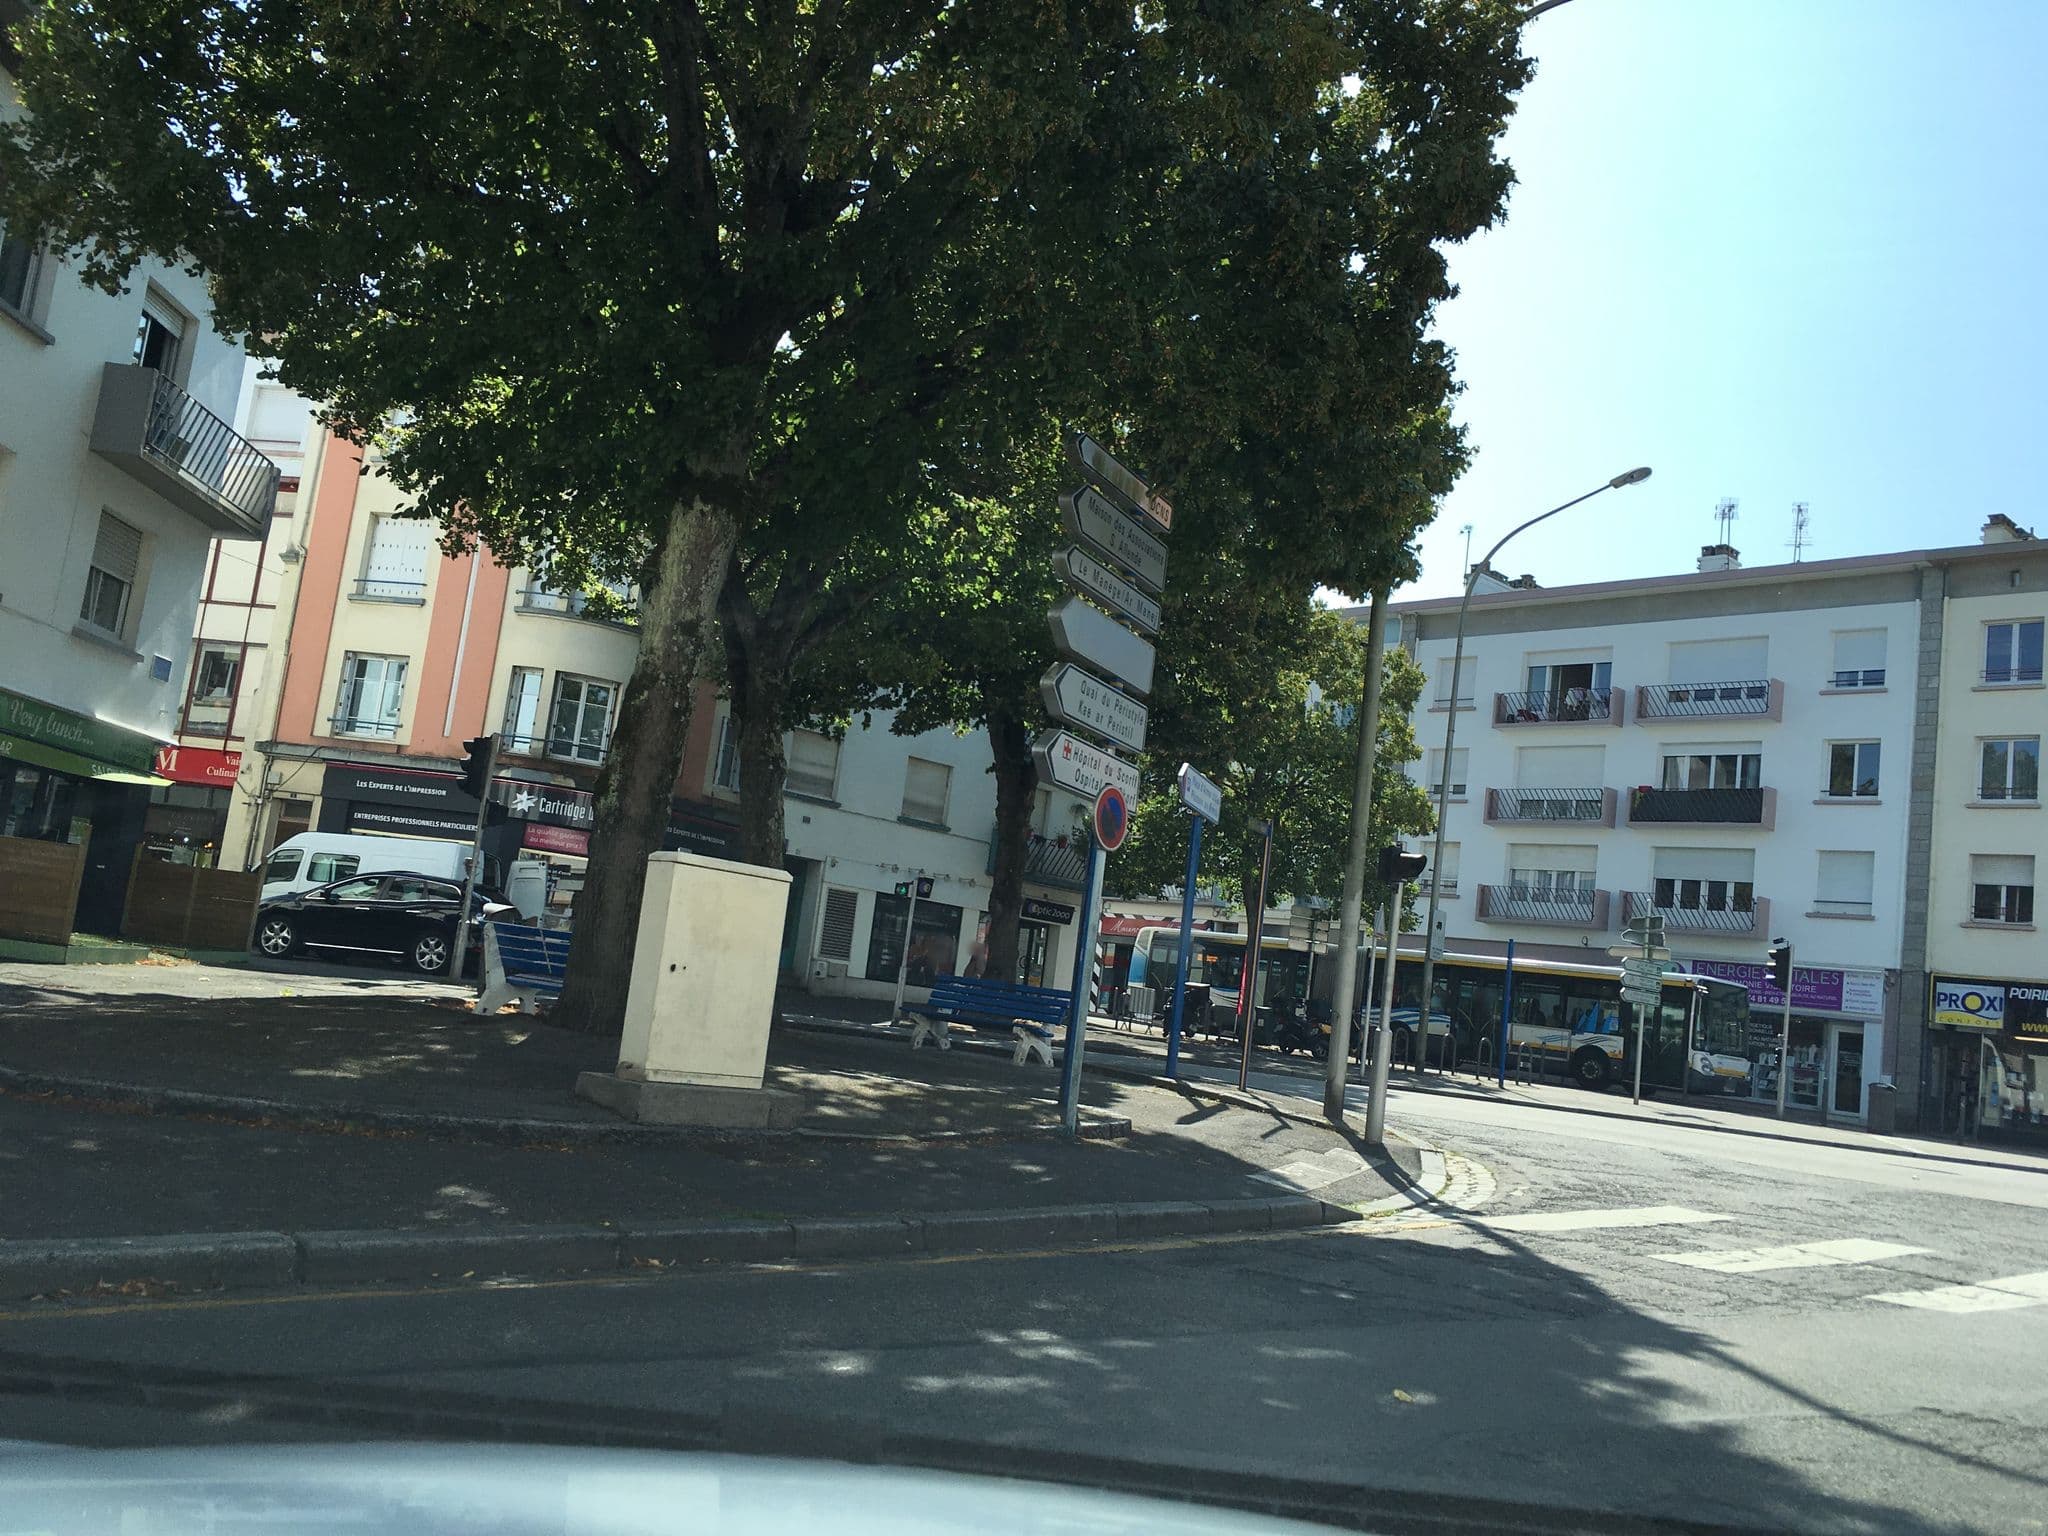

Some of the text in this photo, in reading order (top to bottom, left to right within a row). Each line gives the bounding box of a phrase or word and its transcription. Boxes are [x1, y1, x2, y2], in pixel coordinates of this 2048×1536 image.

[1078, 559, 1088, 577] Le
[1080, 680, 1099, 701] Quai
[1101, 691, 1111, 708] du
[9, 699, 43, 737] Very
[1078, 700, 1092, 719] Kae
[1095, 712, 1104, 724] ar
[1072, 746, 1138, 789] Hôpital du Scorff
[1074, 768, 1103, 793] Ospital
[353, 812, 390, 823] ENTREPRISES
[391, 816, 440, 828] PROFESSIONNELS
[540, 797, 586, 821] Cartridge
[1936, 991, 2004, 1014] PROXI
